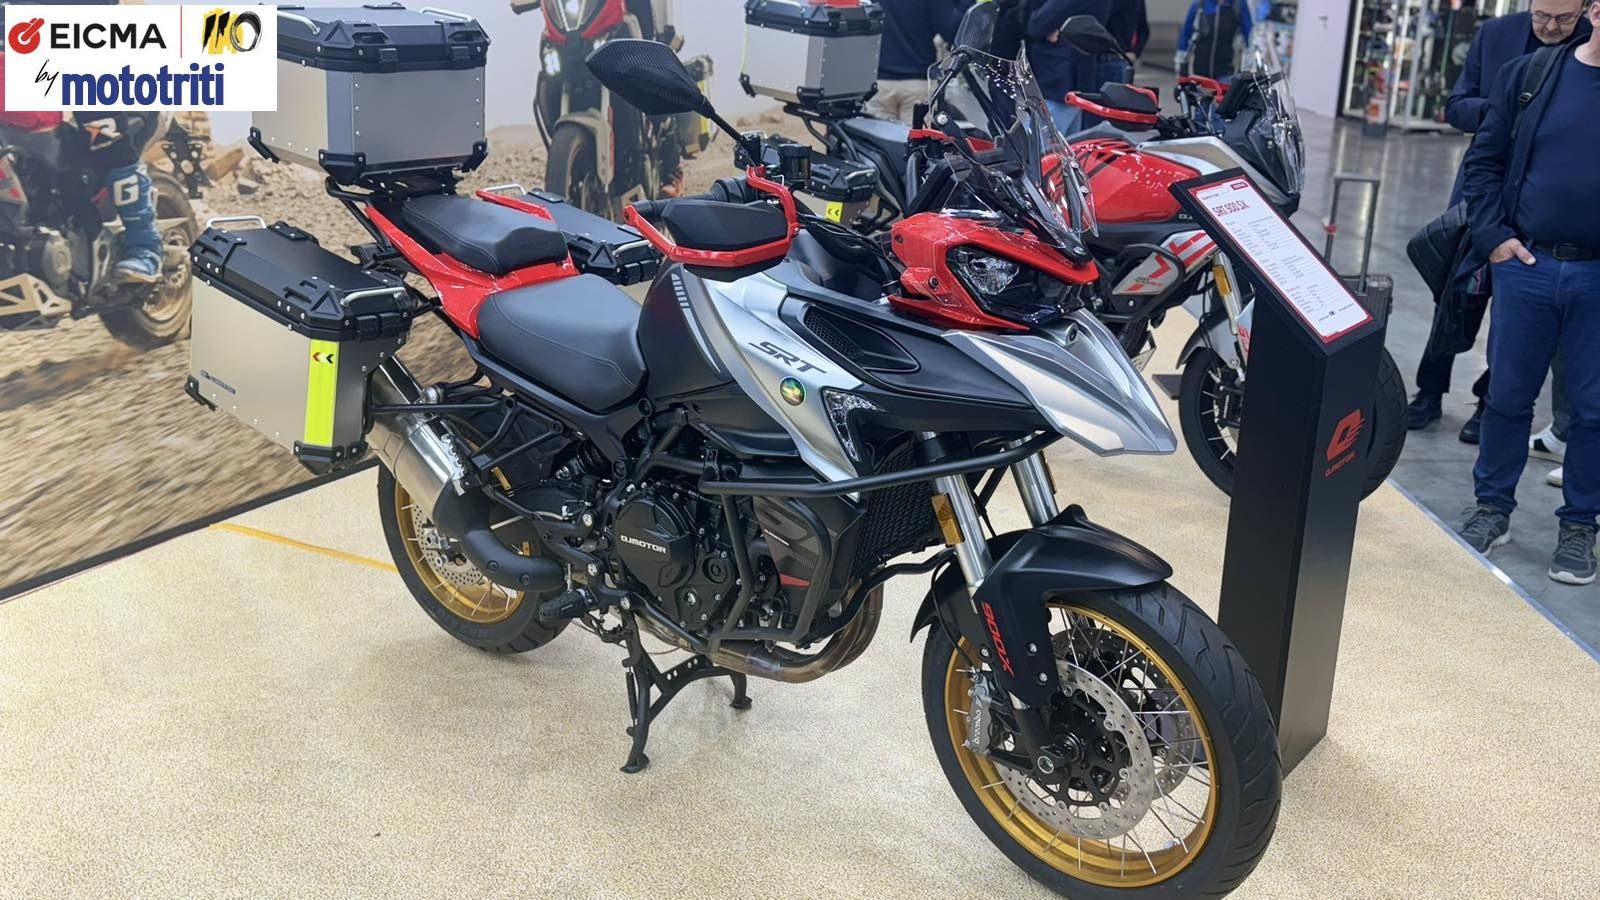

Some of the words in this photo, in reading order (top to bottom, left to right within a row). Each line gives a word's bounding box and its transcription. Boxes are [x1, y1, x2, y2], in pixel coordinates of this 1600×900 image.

[748, 341, 828, 373] SRT
[620, 535, 667, 554] QJMOTOR
[981, 601, 1015, 679] 900X
[972, 709, 982, 745] brembo
